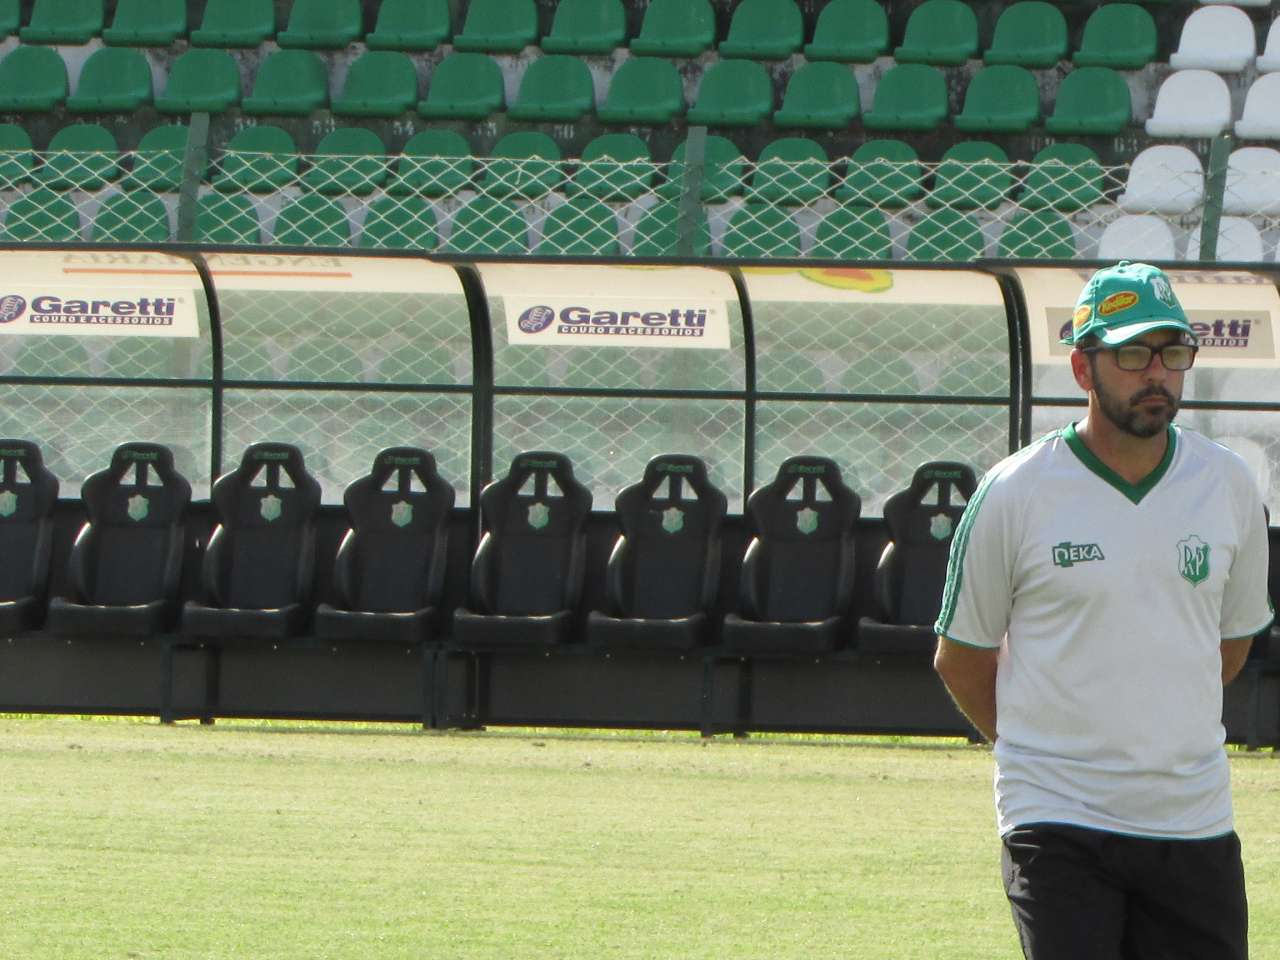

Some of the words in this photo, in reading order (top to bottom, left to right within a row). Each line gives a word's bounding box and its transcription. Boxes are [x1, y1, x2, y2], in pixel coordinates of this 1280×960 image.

[31, 295, 175, 316] Garetti
[33, 314, 76, 323] COURO
[559, 306, 707, 328] Garetti
[561, 325, 604, 334] COURO
[1053, 543, 1103, 566] DEKA
